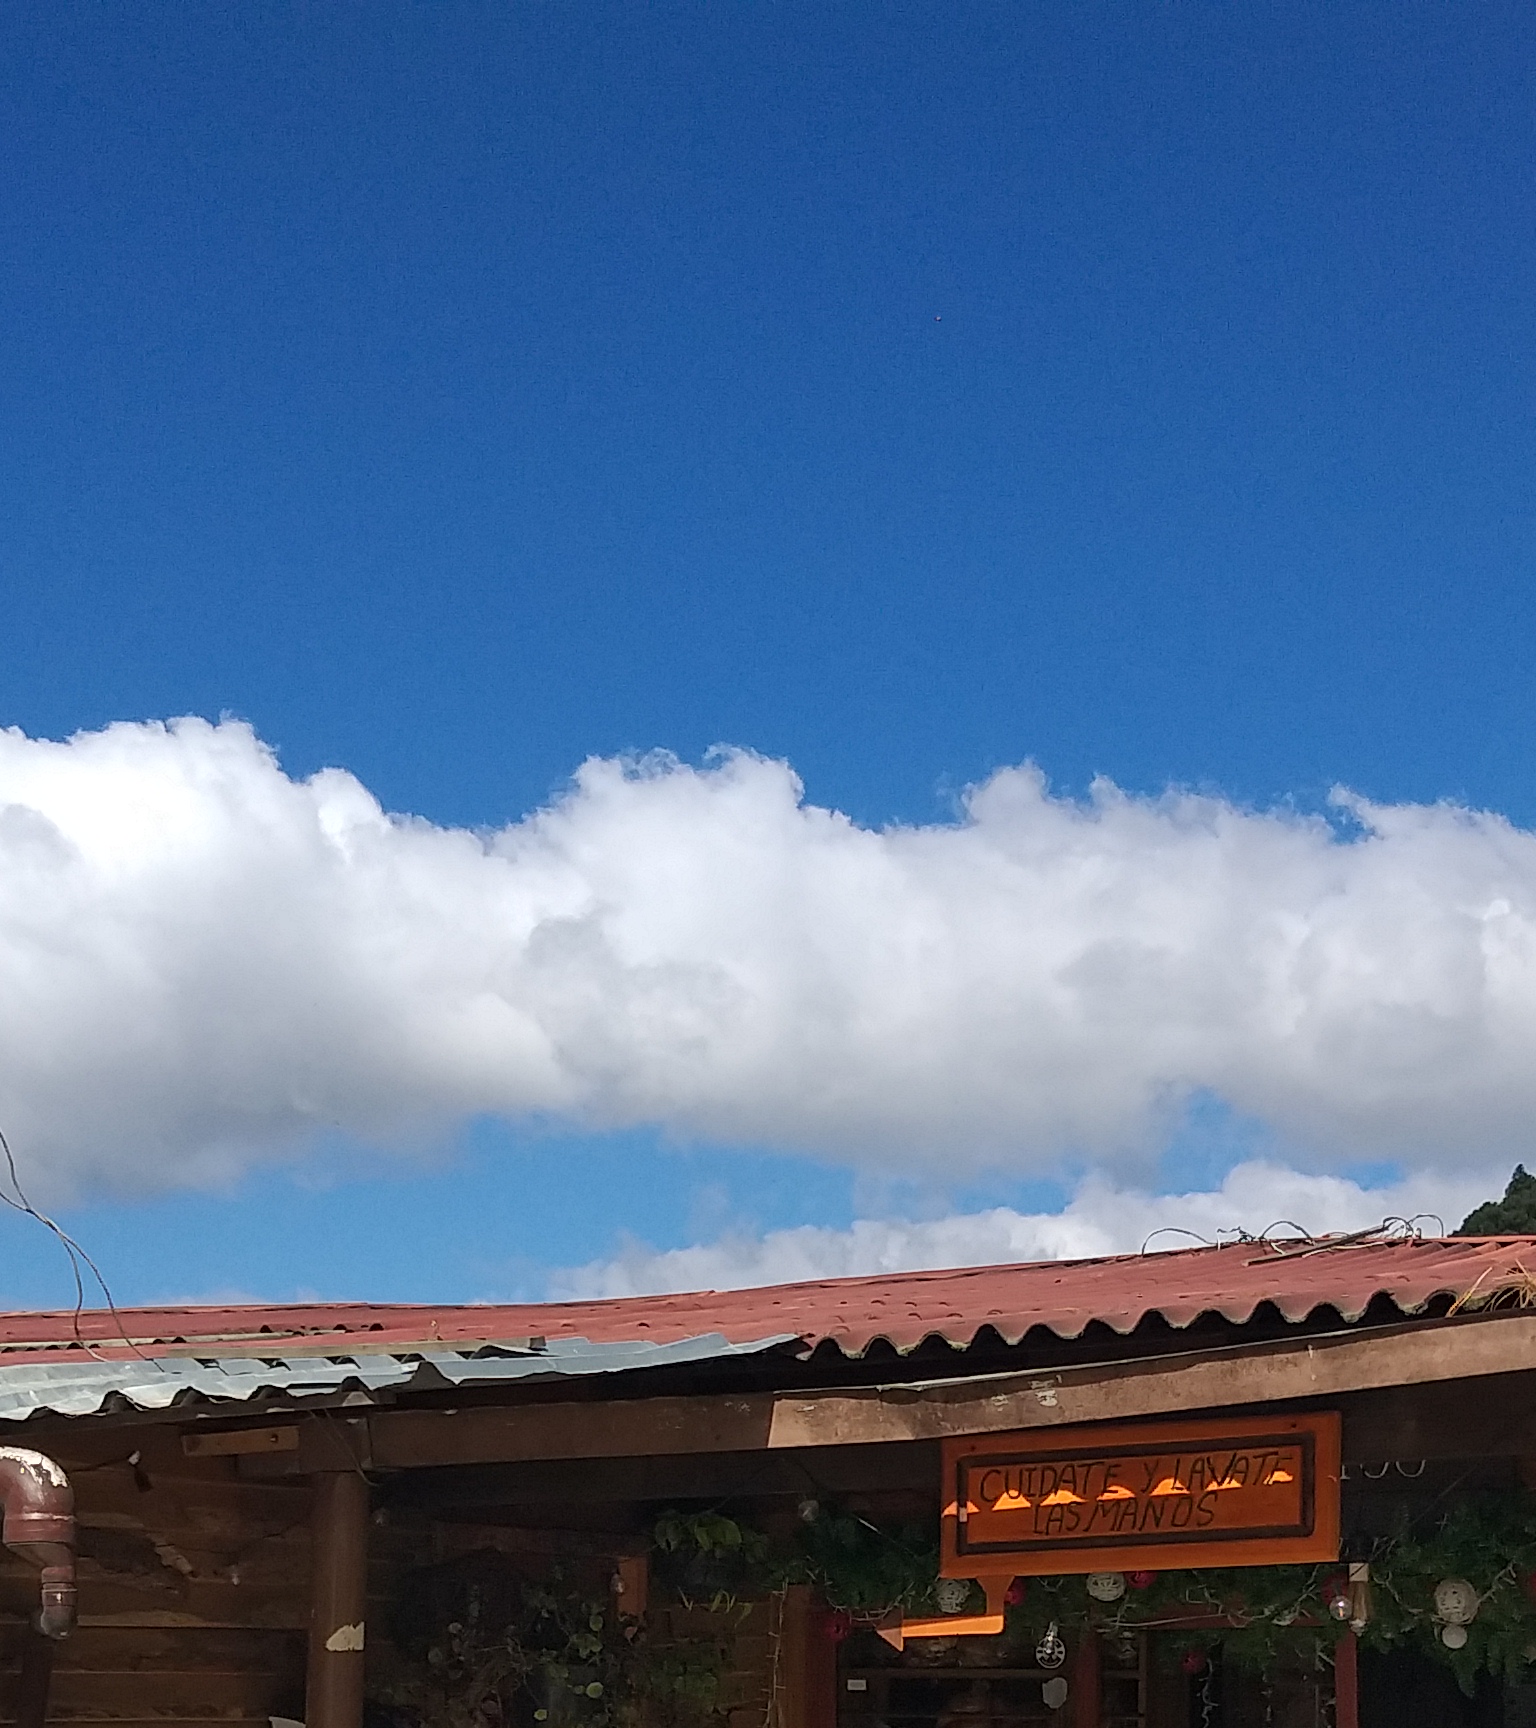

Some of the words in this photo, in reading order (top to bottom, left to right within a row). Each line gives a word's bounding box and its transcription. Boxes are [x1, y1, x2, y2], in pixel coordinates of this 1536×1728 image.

[980, 1461, 1122, 1503] CUIDATE
[1140, 1459, 1160, 1494] Y
[1172, 1451, 1294, 1492] LAVATE
[1032, 1501, 1081, 1536] LAS
[1083, 1491, 1219, 1532] MANOS
